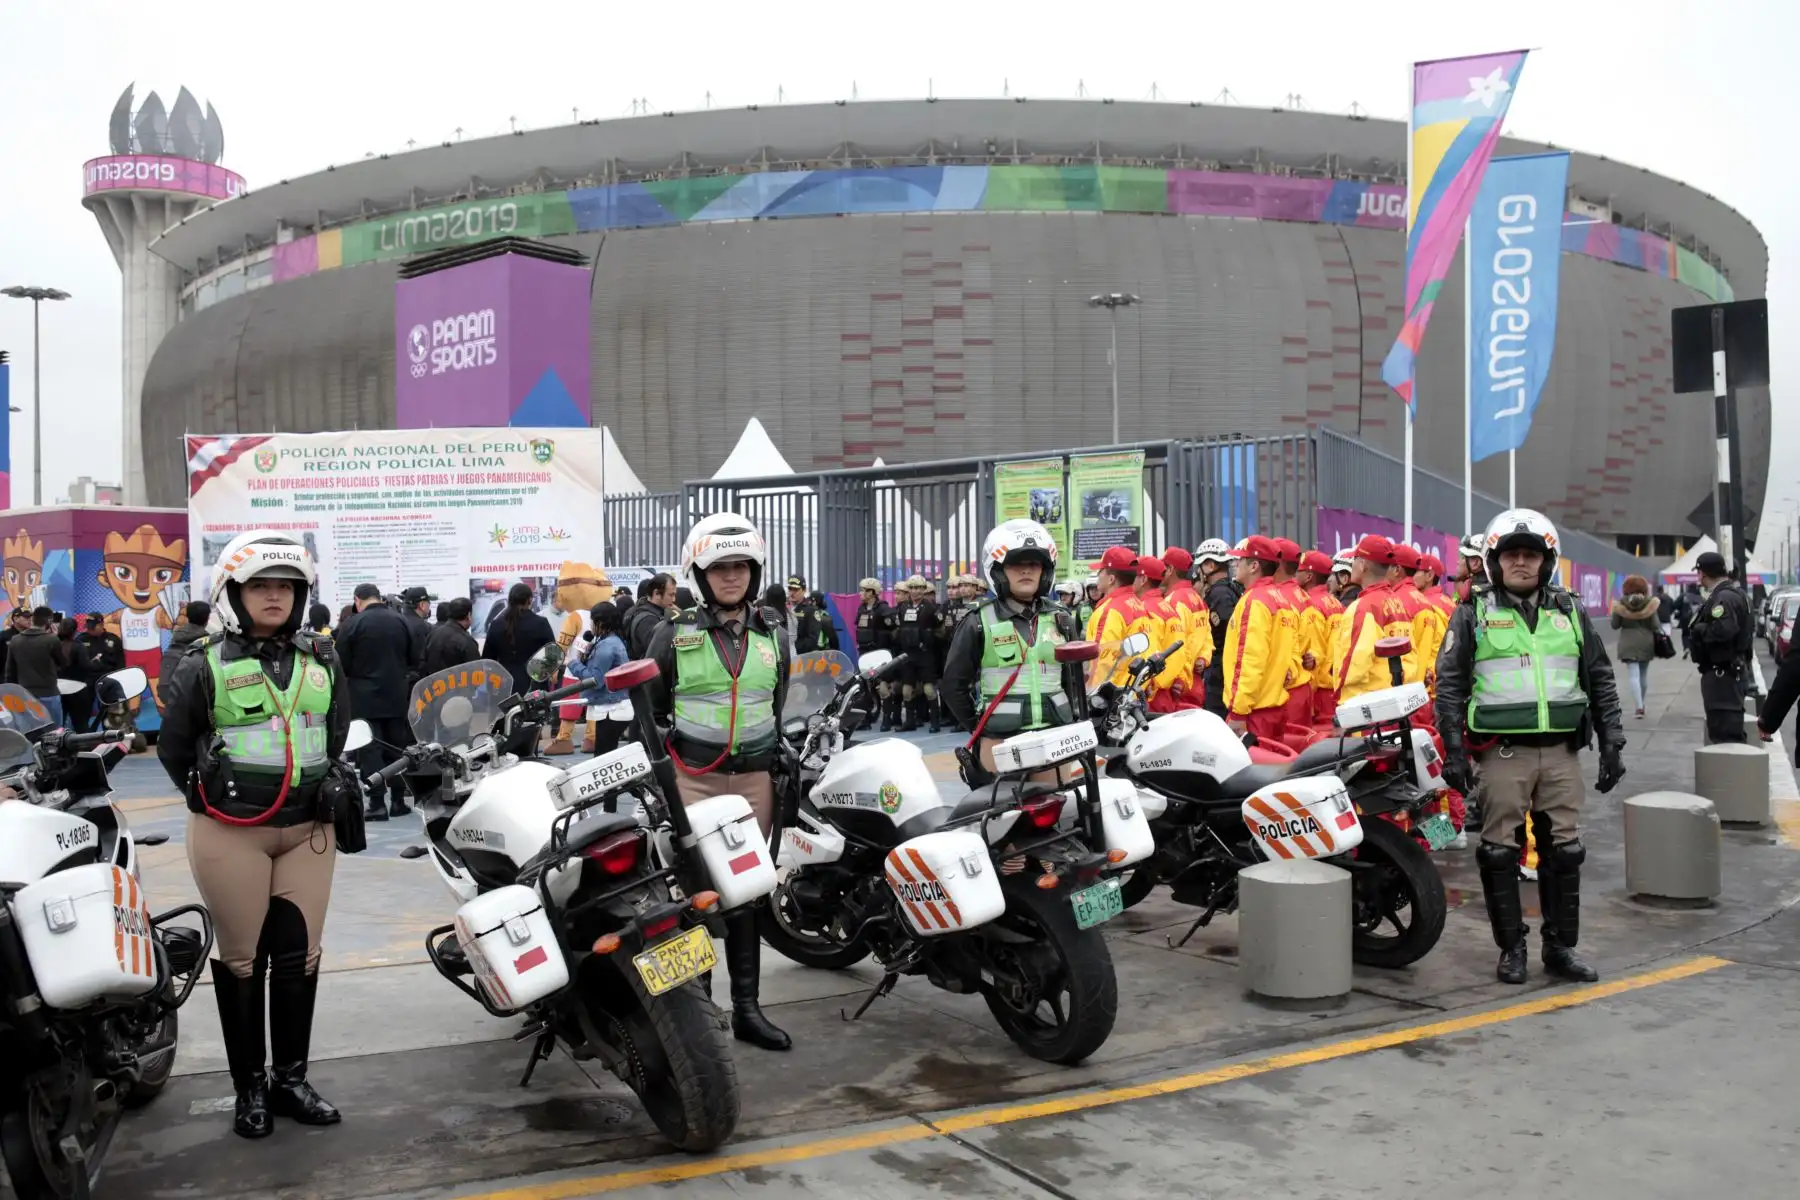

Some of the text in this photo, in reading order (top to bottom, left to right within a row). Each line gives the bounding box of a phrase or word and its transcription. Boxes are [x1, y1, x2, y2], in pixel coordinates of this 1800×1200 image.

[432, 308, 495, 346] PANAM
[431, 336, 497, 375] SPORTS
[280, 442, 528, 459] POLICIA NACIONAL DEL PERU
[303, 456, 505, 472] REGION POLICIAL LIMA
[247, 478, 267, 490] PLAN
[269, 478, 278, 490] DE
[280, 477, 334, 490] OPERACIONES
[336, 476, 380, 488] POLICIALES
[417, 473, 449, 486] PATRIAS
[450, 474, 455, 484] Y
[456, 473, 485, 485] JUEGOS
[487, 472, 552, 484] PANAMERICANOS
[512, 534, 540, 544] 2019
[716, 539, 750, 549] POLICIA
[262, 551, 302, 562] POLICIA
[470, 564, 515, 573] UNIDADES
[126, 628, 149, 638] 2019
[1051, 738, 1094, 758] PAPELETAS
[1060, 735, 1080, 747] FOTO
[592, 761, 623, 780] FOTO
[1140, 758, 1172, 769] PL-18349
[579, 763, 646, 795] PAPELETAS
[821, 792, 854, 805] PL-18273
[55, 823, 91, 851] PL-18365
[1258, 816, 1320, 841] POLICIA
[898, 881, 947, 902] POLICIA
[659, 941, 685, 960] PNP
